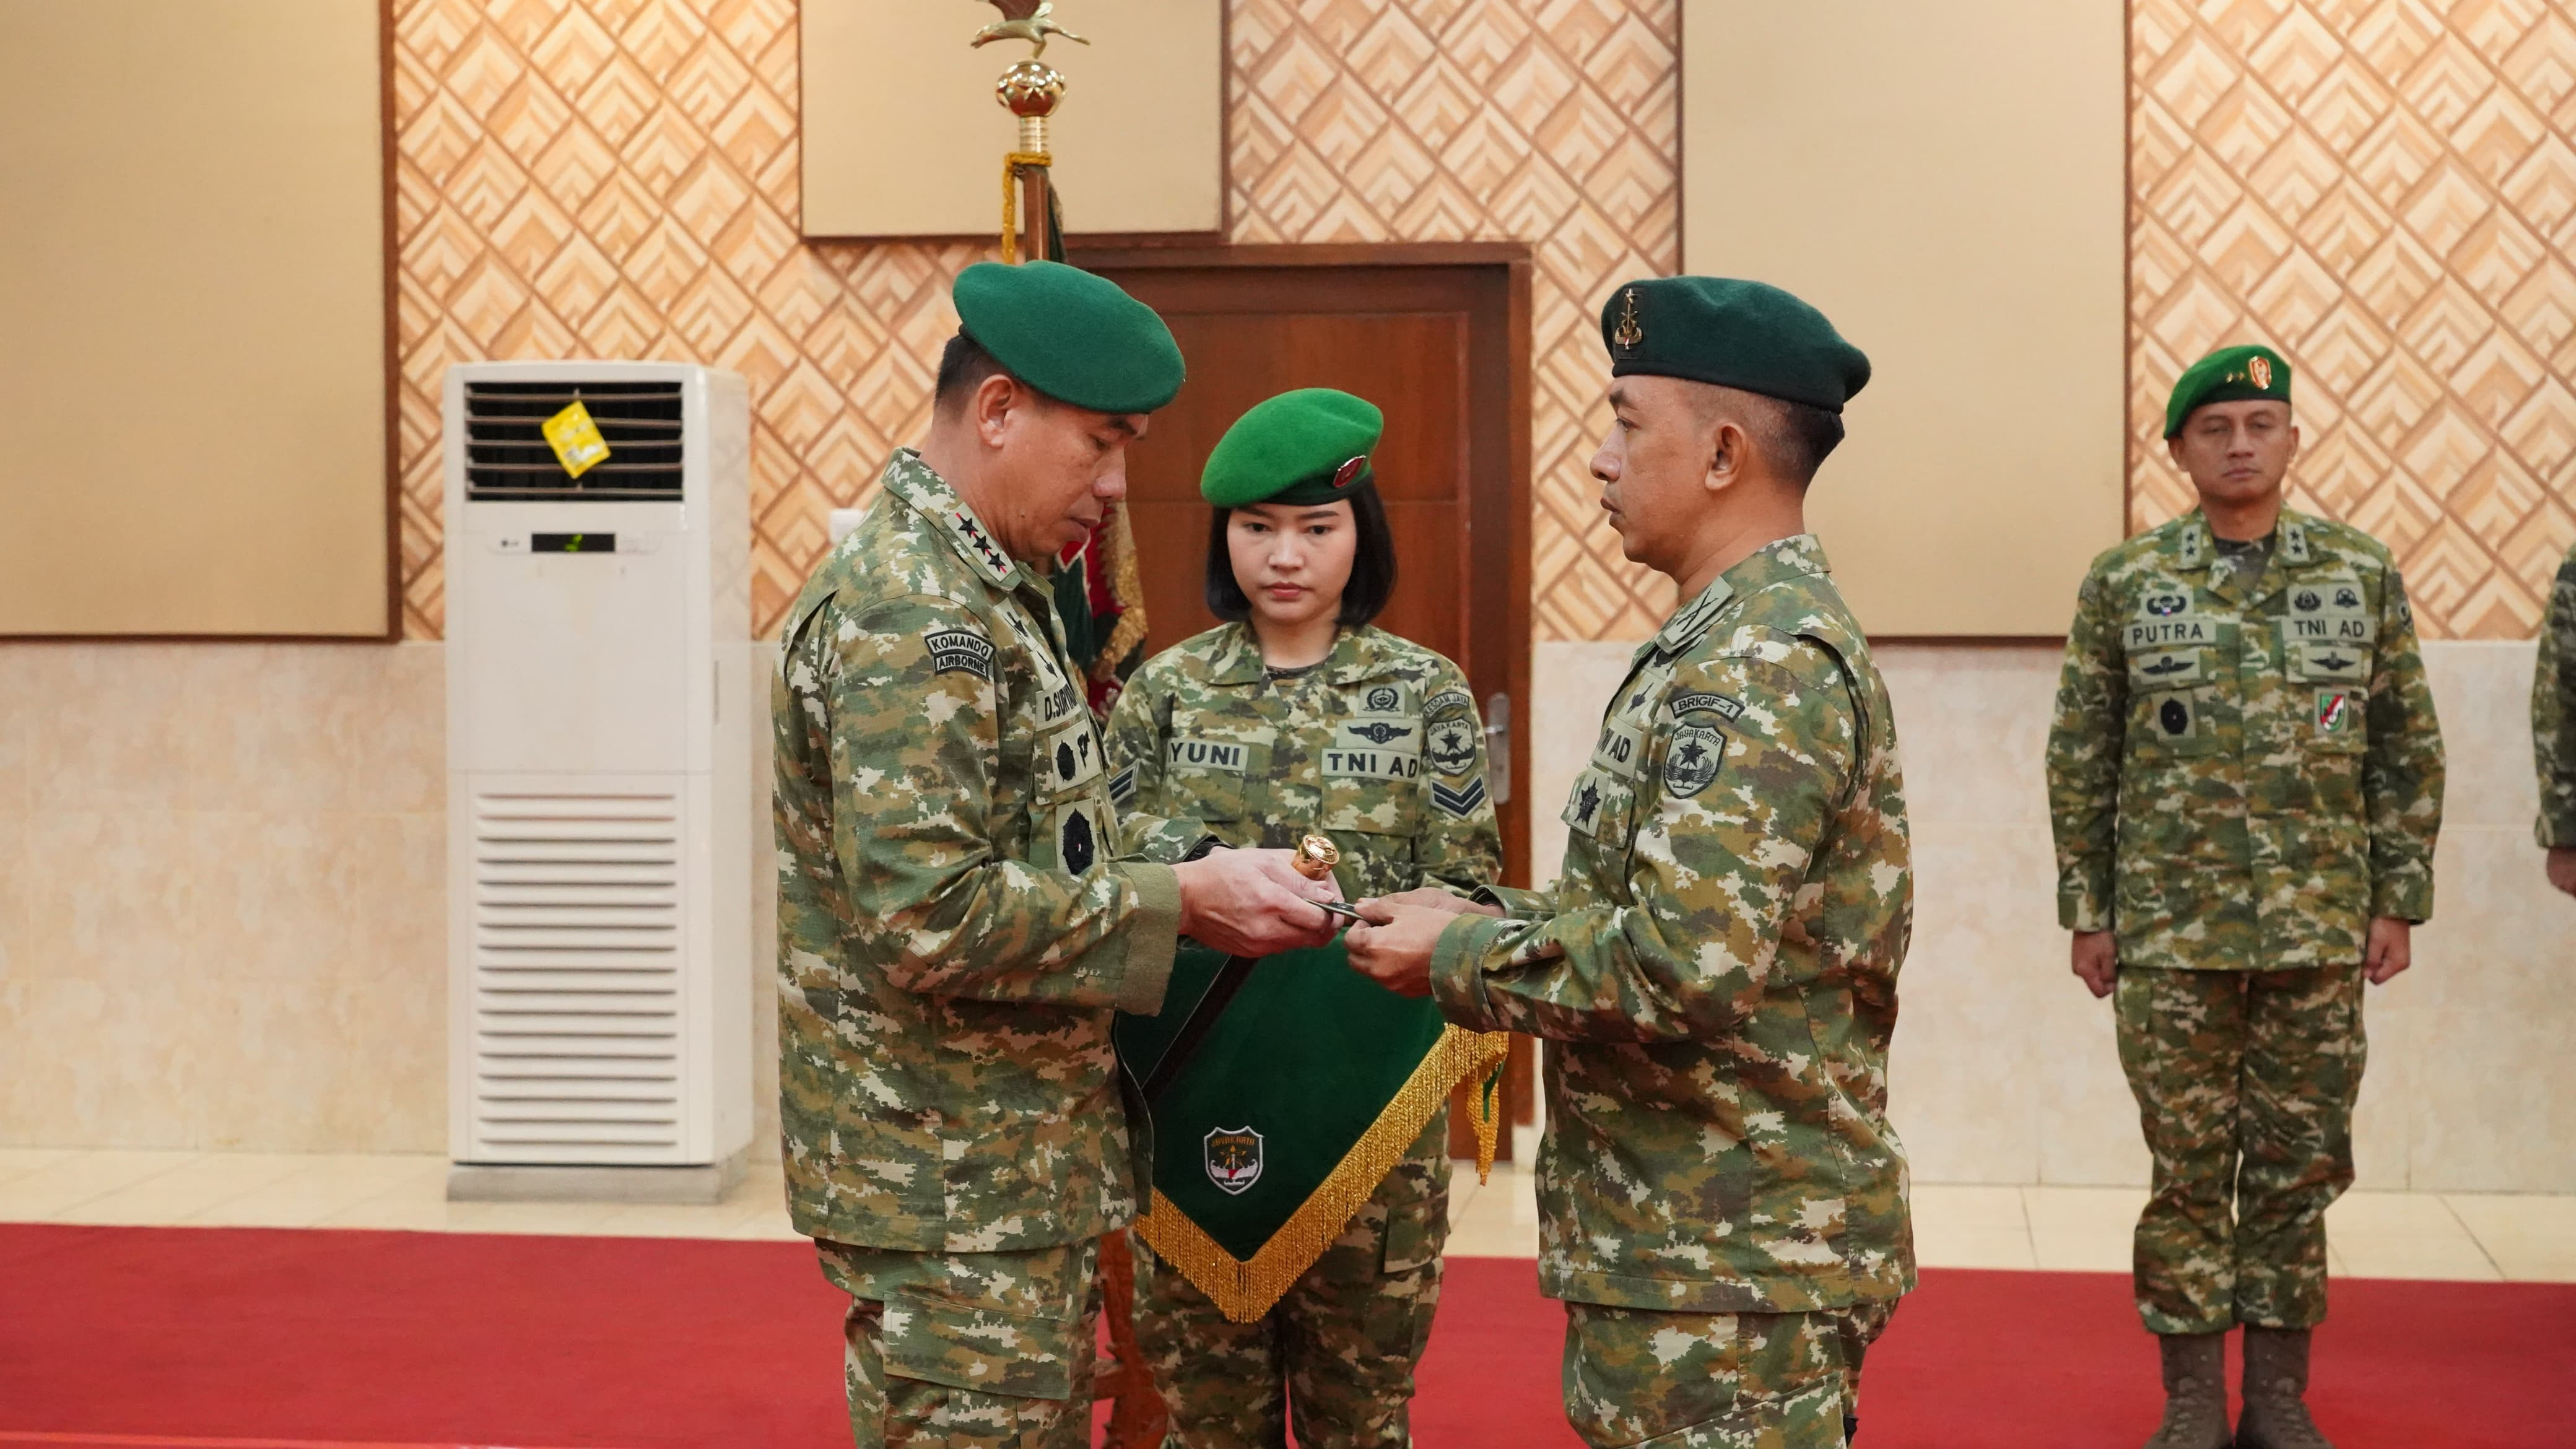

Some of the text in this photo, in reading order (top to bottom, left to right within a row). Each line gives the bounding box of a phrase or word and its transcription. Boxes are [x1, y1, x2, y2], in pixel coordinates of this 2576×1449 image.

[2133, 622, 2204, 645] PUTRA
[2293, 619, 2364, 637] TNI AD
[931, 635, 989, 657] KOMANDO
[939, 655, 986, 674] AIRBORNE
[1678, 696, 1734, 713] BRIGIF-1
[1429, 720, 1469, 736] JAYAKARTA
[1674, 728, 1721, 747] JAYAKARTA
[1608, 734, 1631, 763] AD
[1327, 753, 1418, 778] TNI AD
